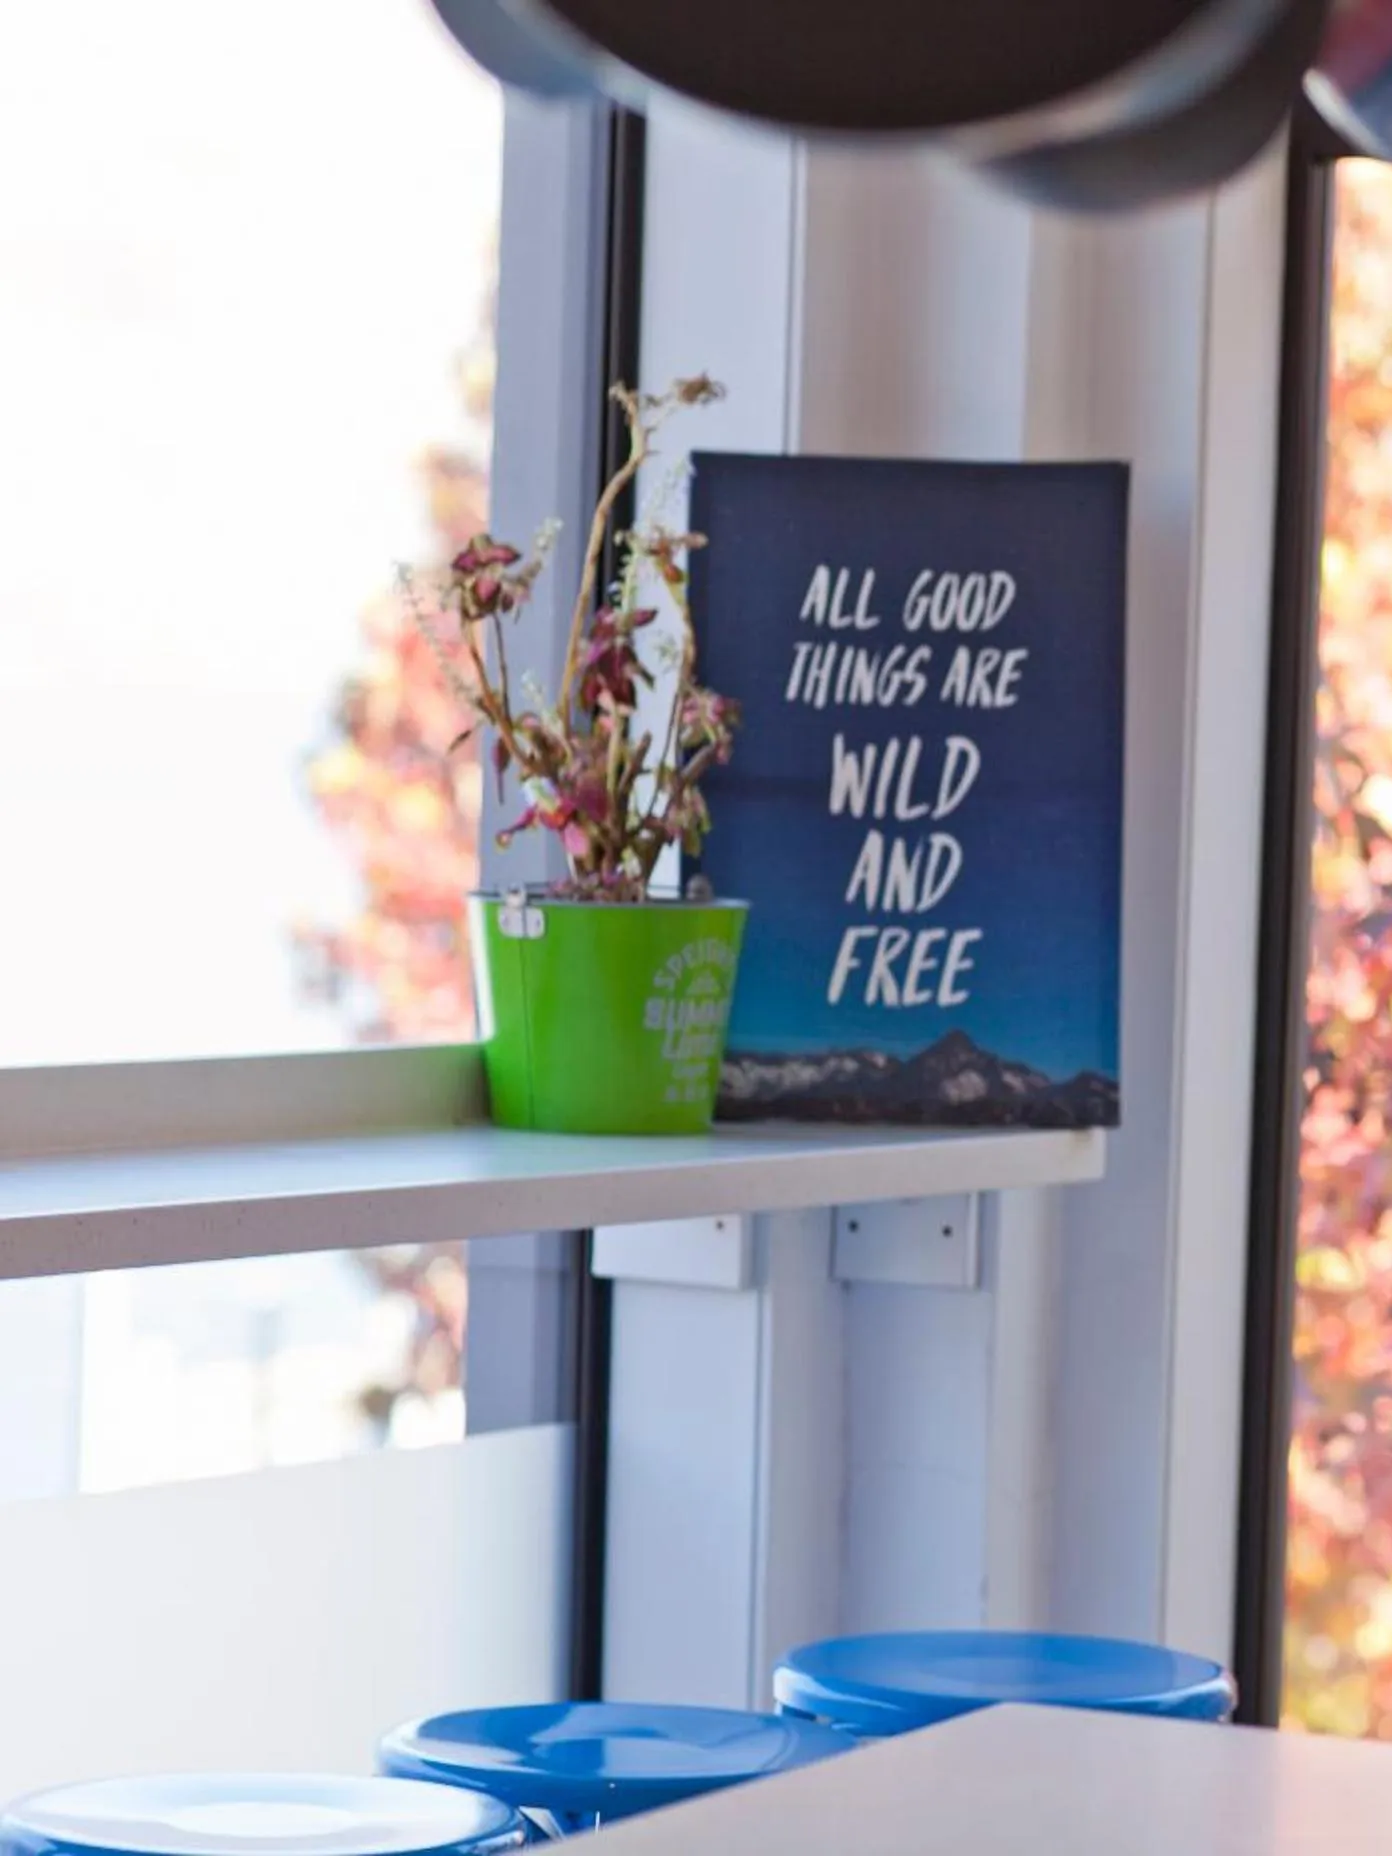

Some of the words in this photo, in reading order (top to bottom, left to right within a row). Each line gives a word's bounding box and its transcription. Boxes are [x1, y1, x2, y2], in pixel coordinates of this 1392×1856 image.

[801, 565, 878, 629] ALL
[904, 570, 1015, 630] GOOD
[787, 642, 931, 708] THINGS
[942, 647, 1027, 707] ARE
[830, 734, 980, 819] WILD
[846, 830, 961, 912] AND
[829, 927, 981, 1005] FREE
